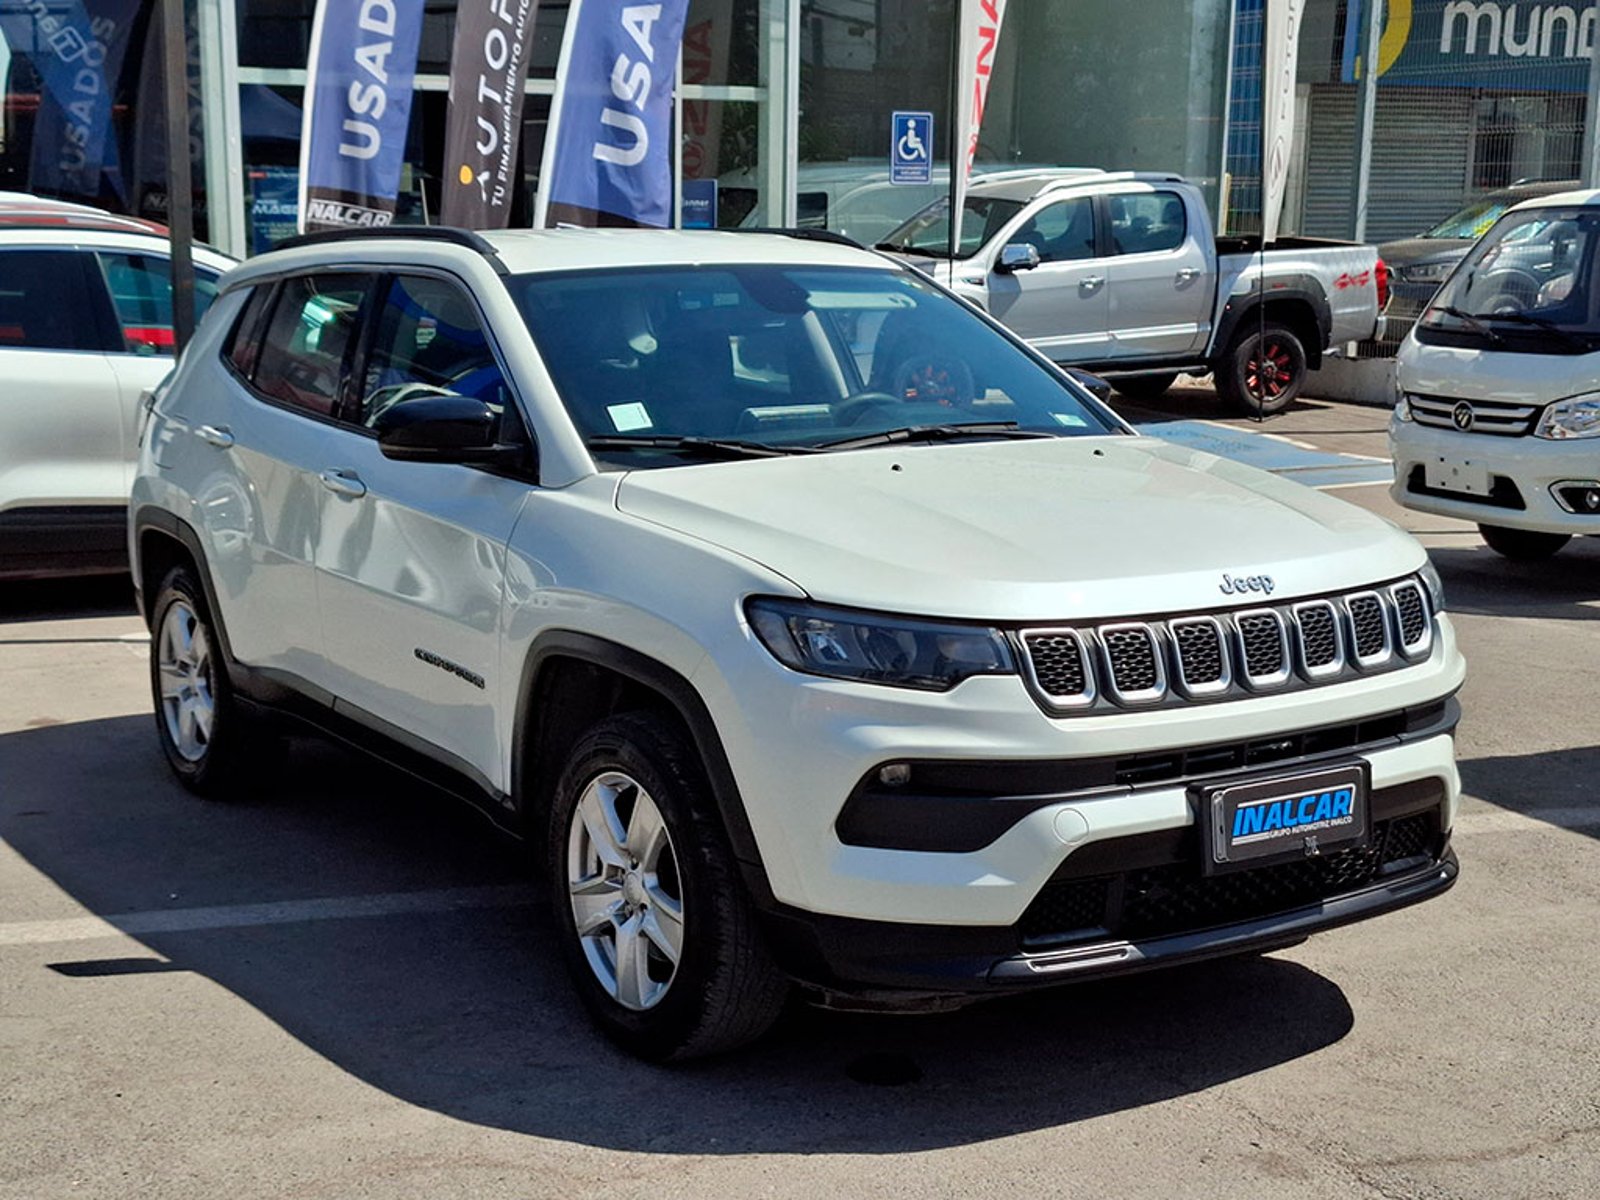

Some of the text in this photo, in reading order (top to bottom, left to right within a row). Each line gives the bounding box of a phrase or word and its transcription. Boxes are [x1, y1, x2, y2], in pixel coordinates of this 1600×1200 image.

[59, 15, 116, 171] USADOS
[491, 185, 505, 206] TU
[308, 202, 389, 227] NALCAR
[1219, 574, 1275, 595] Jeep
[1232, 790, 1351, 836] INALCAR
[1269, 827, 1291, 839] GRUPO
